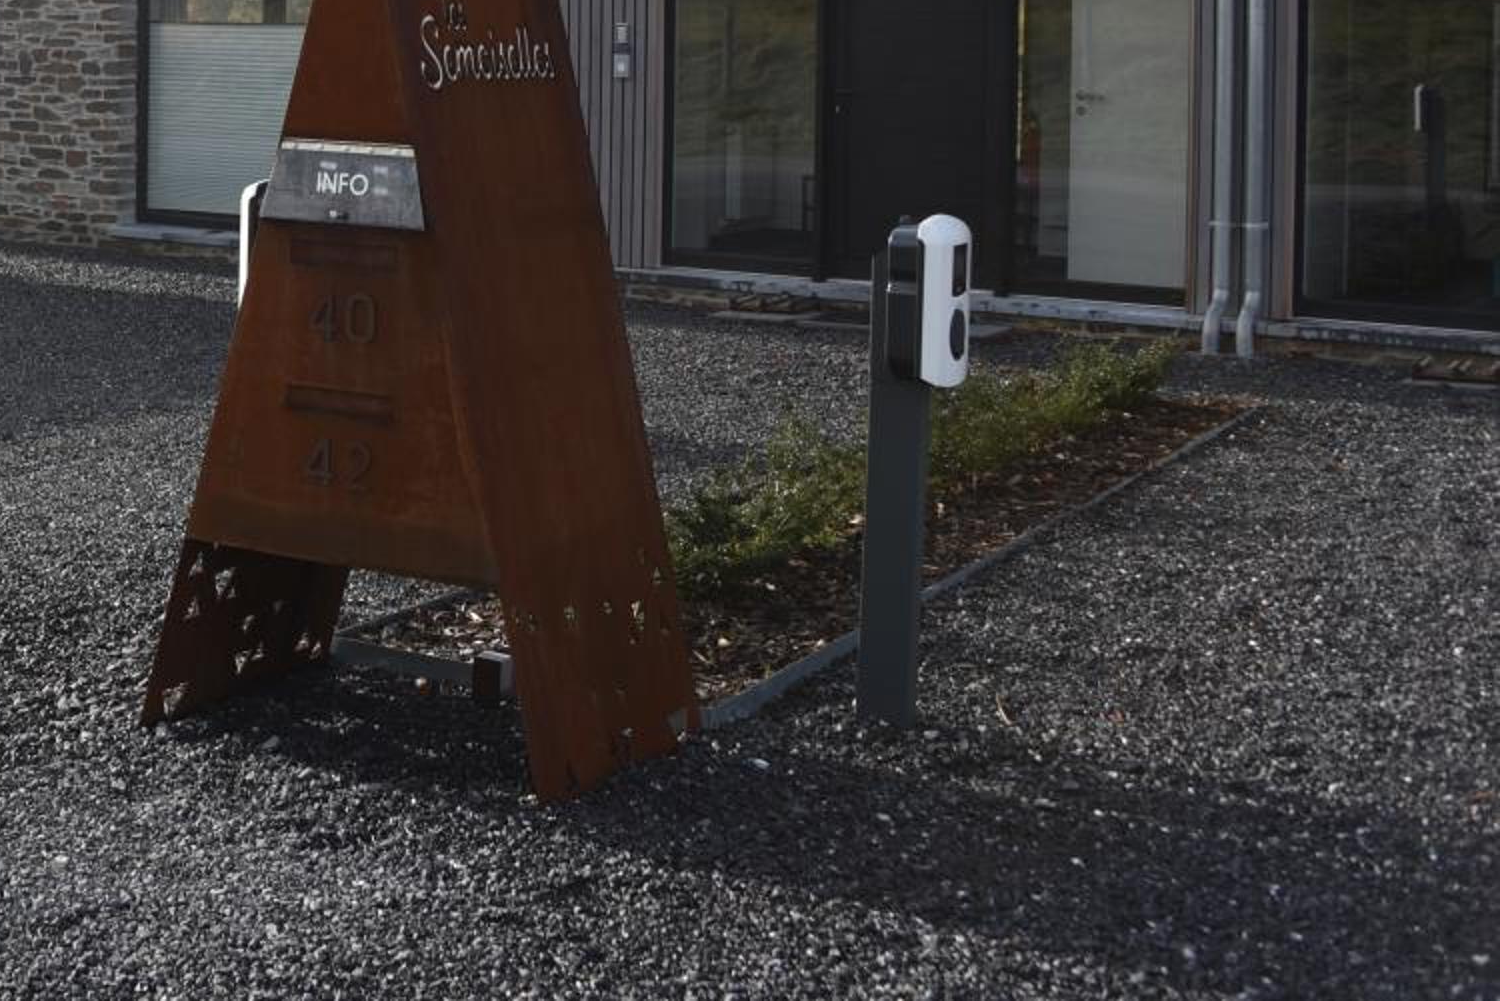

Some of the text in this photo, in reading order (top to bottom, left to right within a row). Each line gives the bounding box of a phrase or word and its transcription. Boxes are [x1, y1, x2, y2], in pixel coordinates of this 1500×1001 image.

[315, 170, 370, 196] INFO
[307, 293, 376, 344] 40
[306, 439, 372, 495] 42
